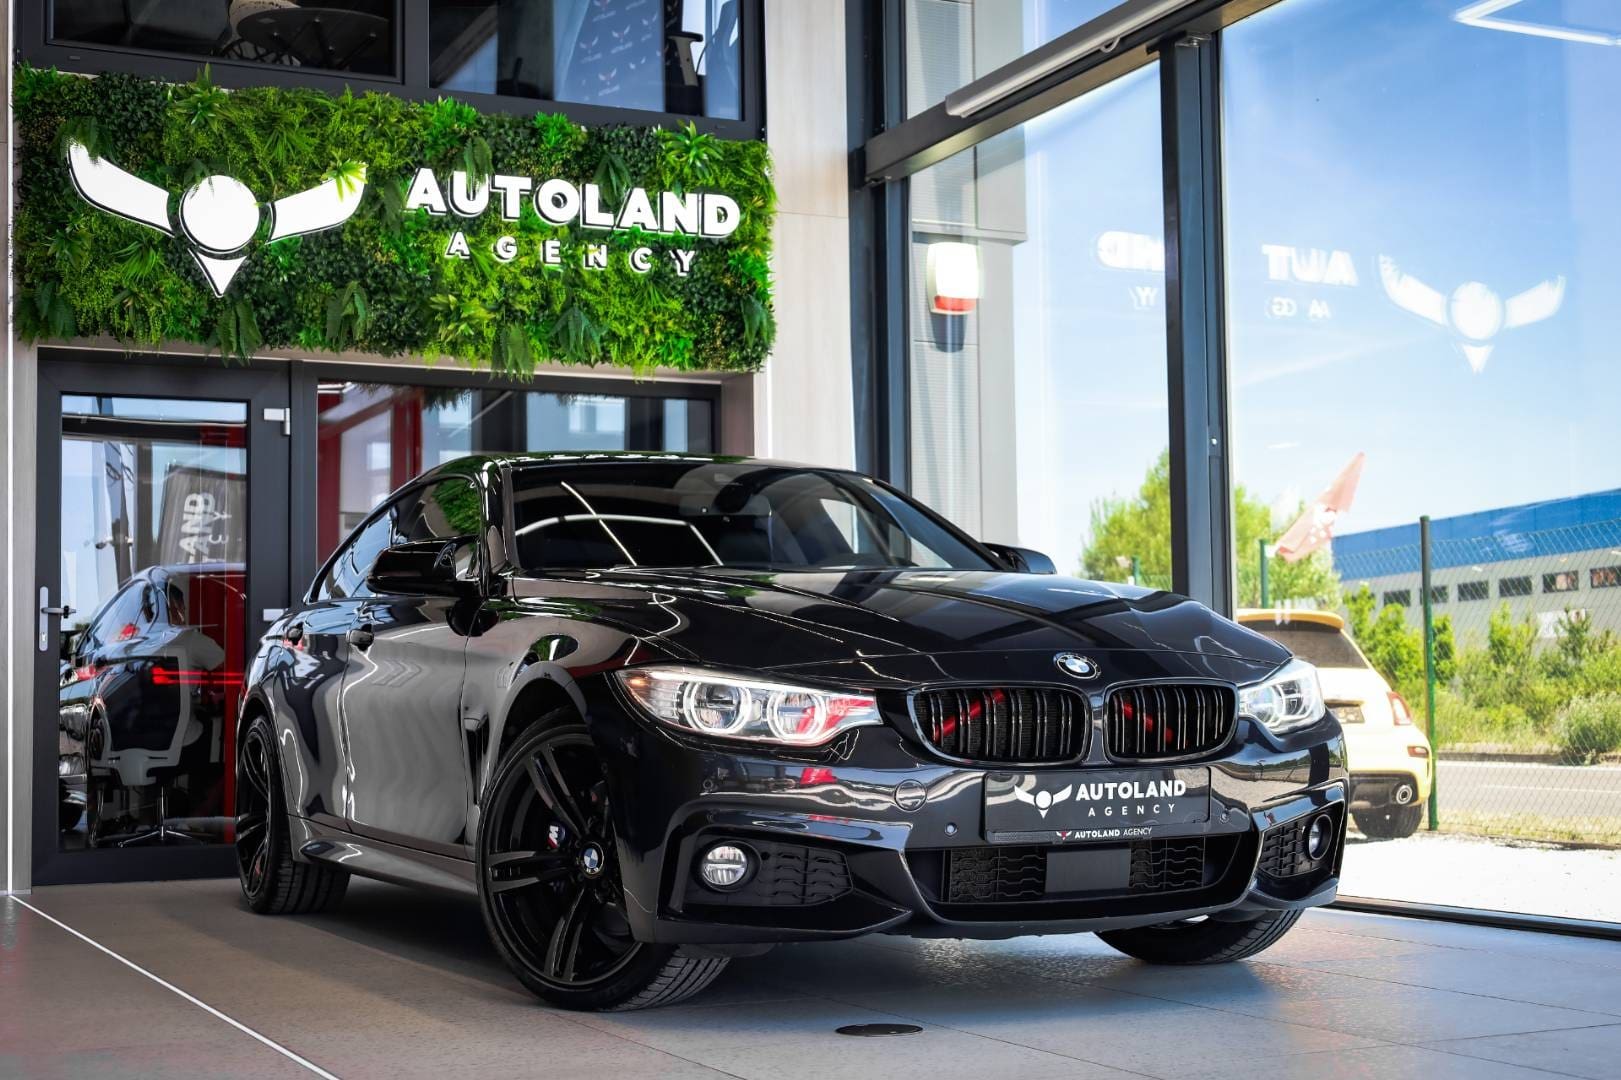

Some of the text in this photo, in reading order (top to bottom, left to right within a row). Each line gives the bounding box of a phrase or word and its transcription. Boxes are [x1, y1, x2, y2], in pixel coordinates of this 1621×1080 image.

[404, 167, 741, 238] AUTOLAND
[445, 231, 696, 277] AGENCY
[1075, 779, 1187, 801] AUTOLAND
[1087, 803, 1176, 817] AGENCY
[1074, 827, 1152, 839] AUTOLAND AGENCY
